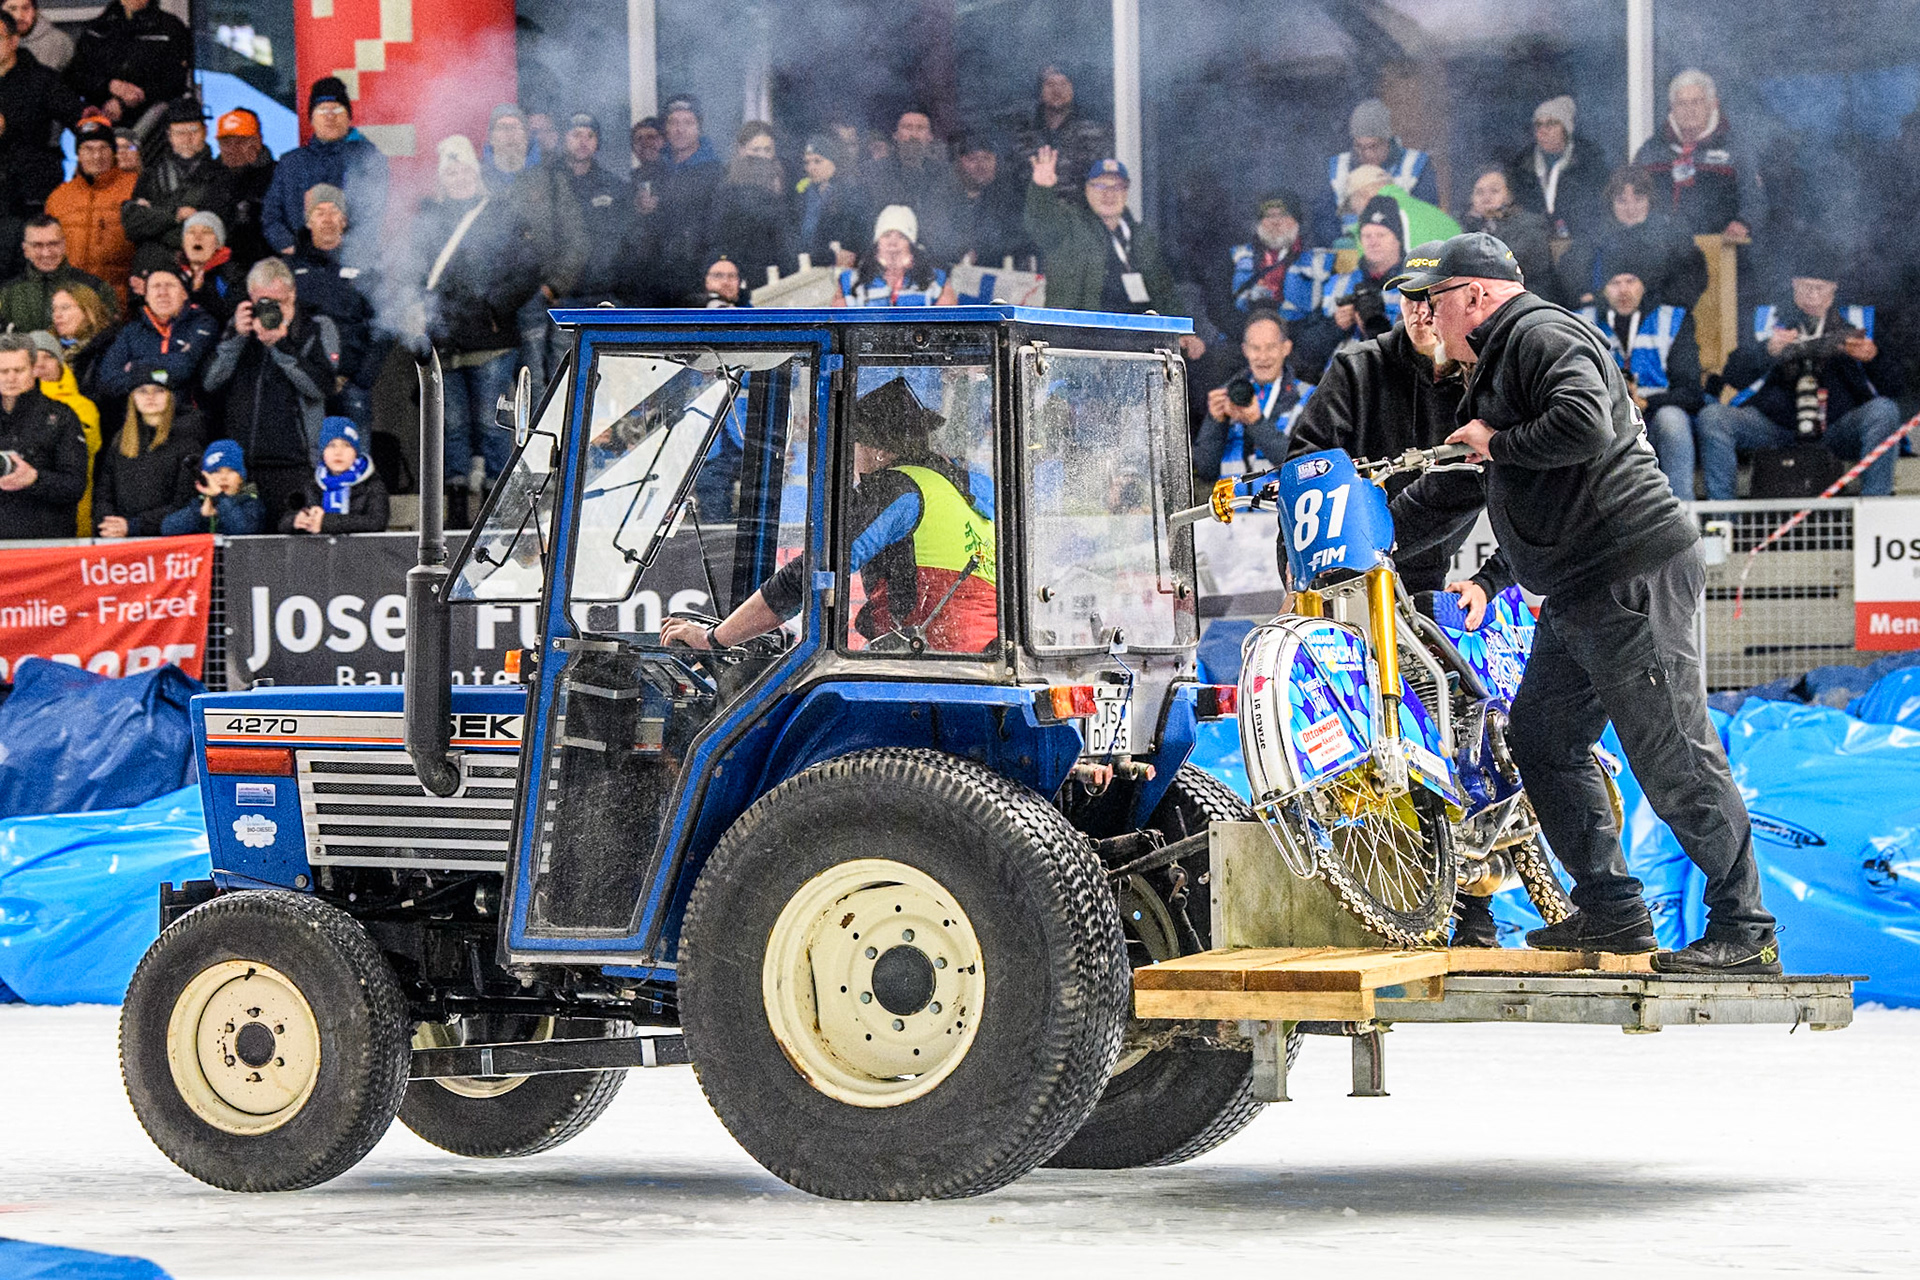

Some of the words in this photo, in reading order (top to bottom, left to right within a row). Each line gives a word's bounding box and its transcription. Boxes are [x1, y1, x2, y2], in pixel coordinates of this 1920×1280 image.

[1293, 483, 1350, 552] 81
[80, 556, 155, 586] Ideal
[163, 552, 203, 581] für
[1307, 545, 1347, 572] FIM
[97, 590, 199, 625] Freizet
[246, 586, 407, 673] Jose
[1869, 613, 1920, 635] Men
[226, 718, 298, 734] 4270
[449, 714, 519, 739] EK
[1104, 702, 1118, 724] TS
